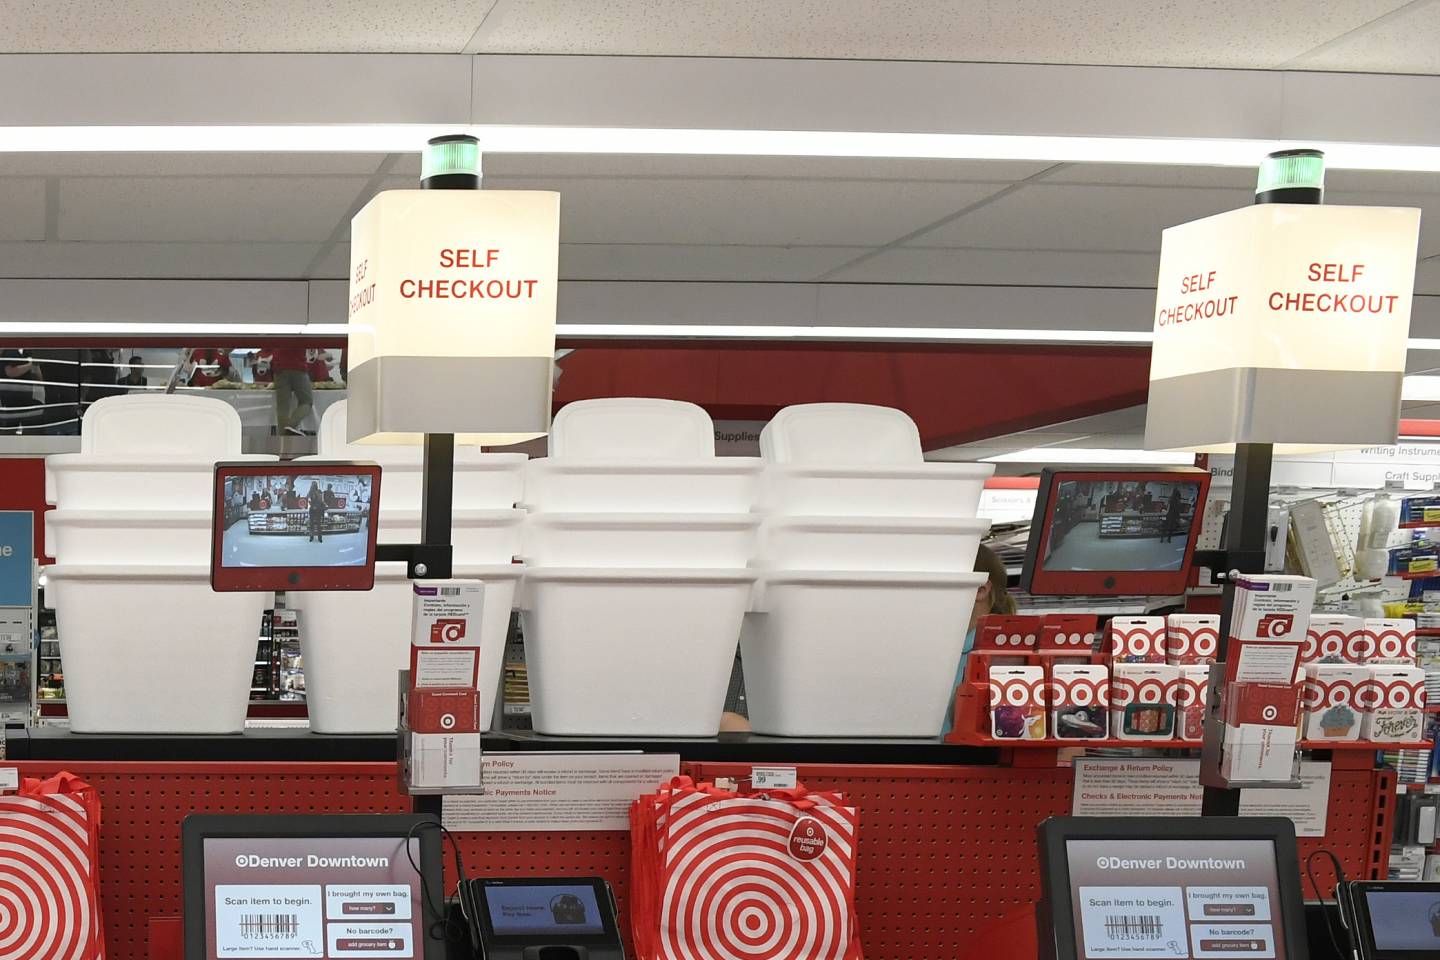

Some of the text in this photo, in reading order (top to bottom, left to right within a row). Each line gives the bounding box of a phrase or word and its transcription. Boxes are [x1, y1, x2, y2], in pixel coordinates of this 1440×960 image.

[440, 249, 499, 268] SELF
[1308, 262, 1365, 283] SELF
[1181, 271, 1216, 294] SELF
[400, 280, 538, 298] CHECKOUT
[1268, 292, 1399, 314] CHECKOUT
[1158, 296, 1238, 327] CHECKOUT
[1360, 447, 1440, 457] Writing Instrume
[1211, 468, 1233, 477] Bind
[1385, 472, 1440, 482] Craft Supp
[492, 760, 514, 768] Policy
[793, 836, 824, 847] reusable
[800, 844, 815, 854] bag
[250, 855, 389, 868] Denver Downtown
[1110, 857, 1246, 869] Denver Downtown
[1193, 892, 1221, 900] brought
[225, 898, 313, 907] Scan item to begin.
[1089, 899, 1175, 908] Scan item to begin.
